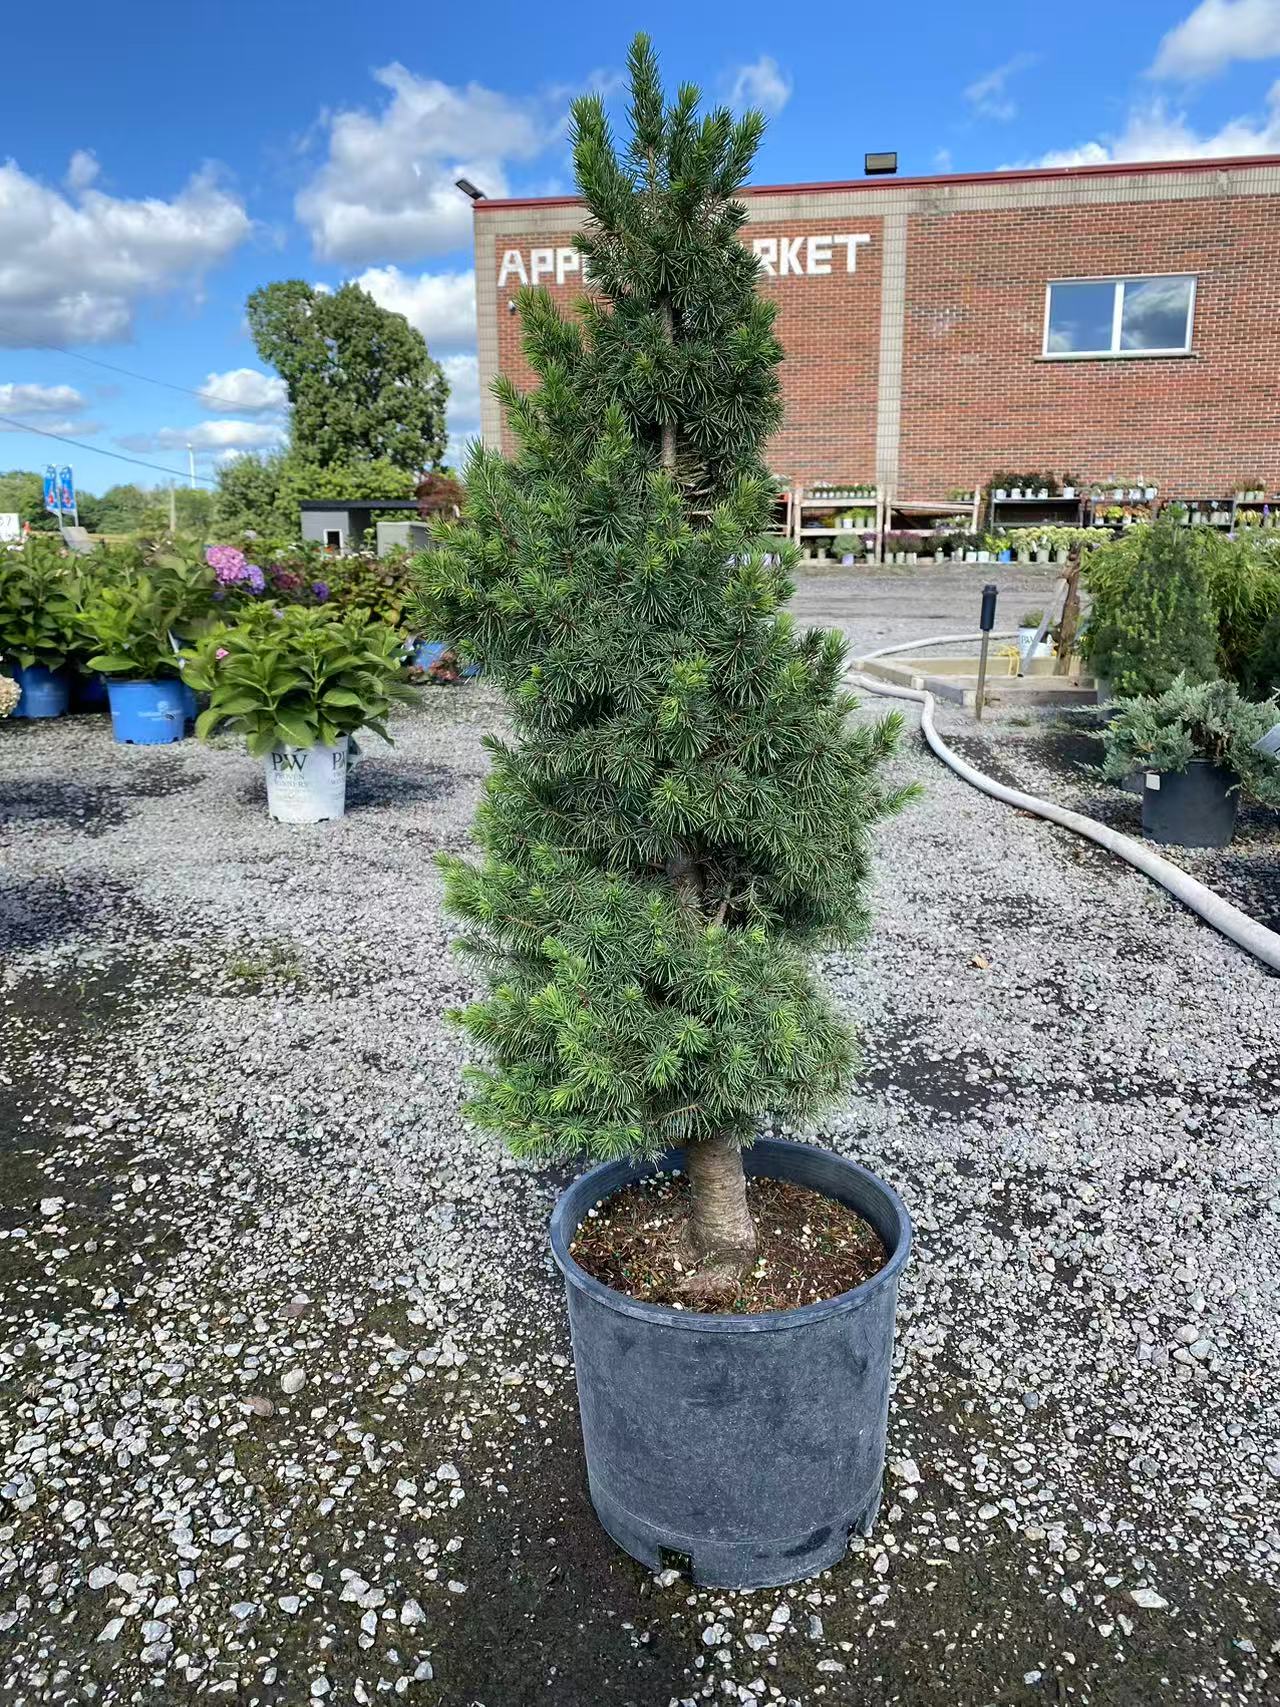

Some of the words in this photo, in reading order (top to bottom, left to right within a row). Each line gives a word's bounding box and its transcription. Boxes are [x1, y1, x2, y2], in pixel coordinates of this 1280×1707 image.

[752, 233, 871, 277] RKET
[271, 752, 308, 772] PW
[332, 751, 345, 770] P
